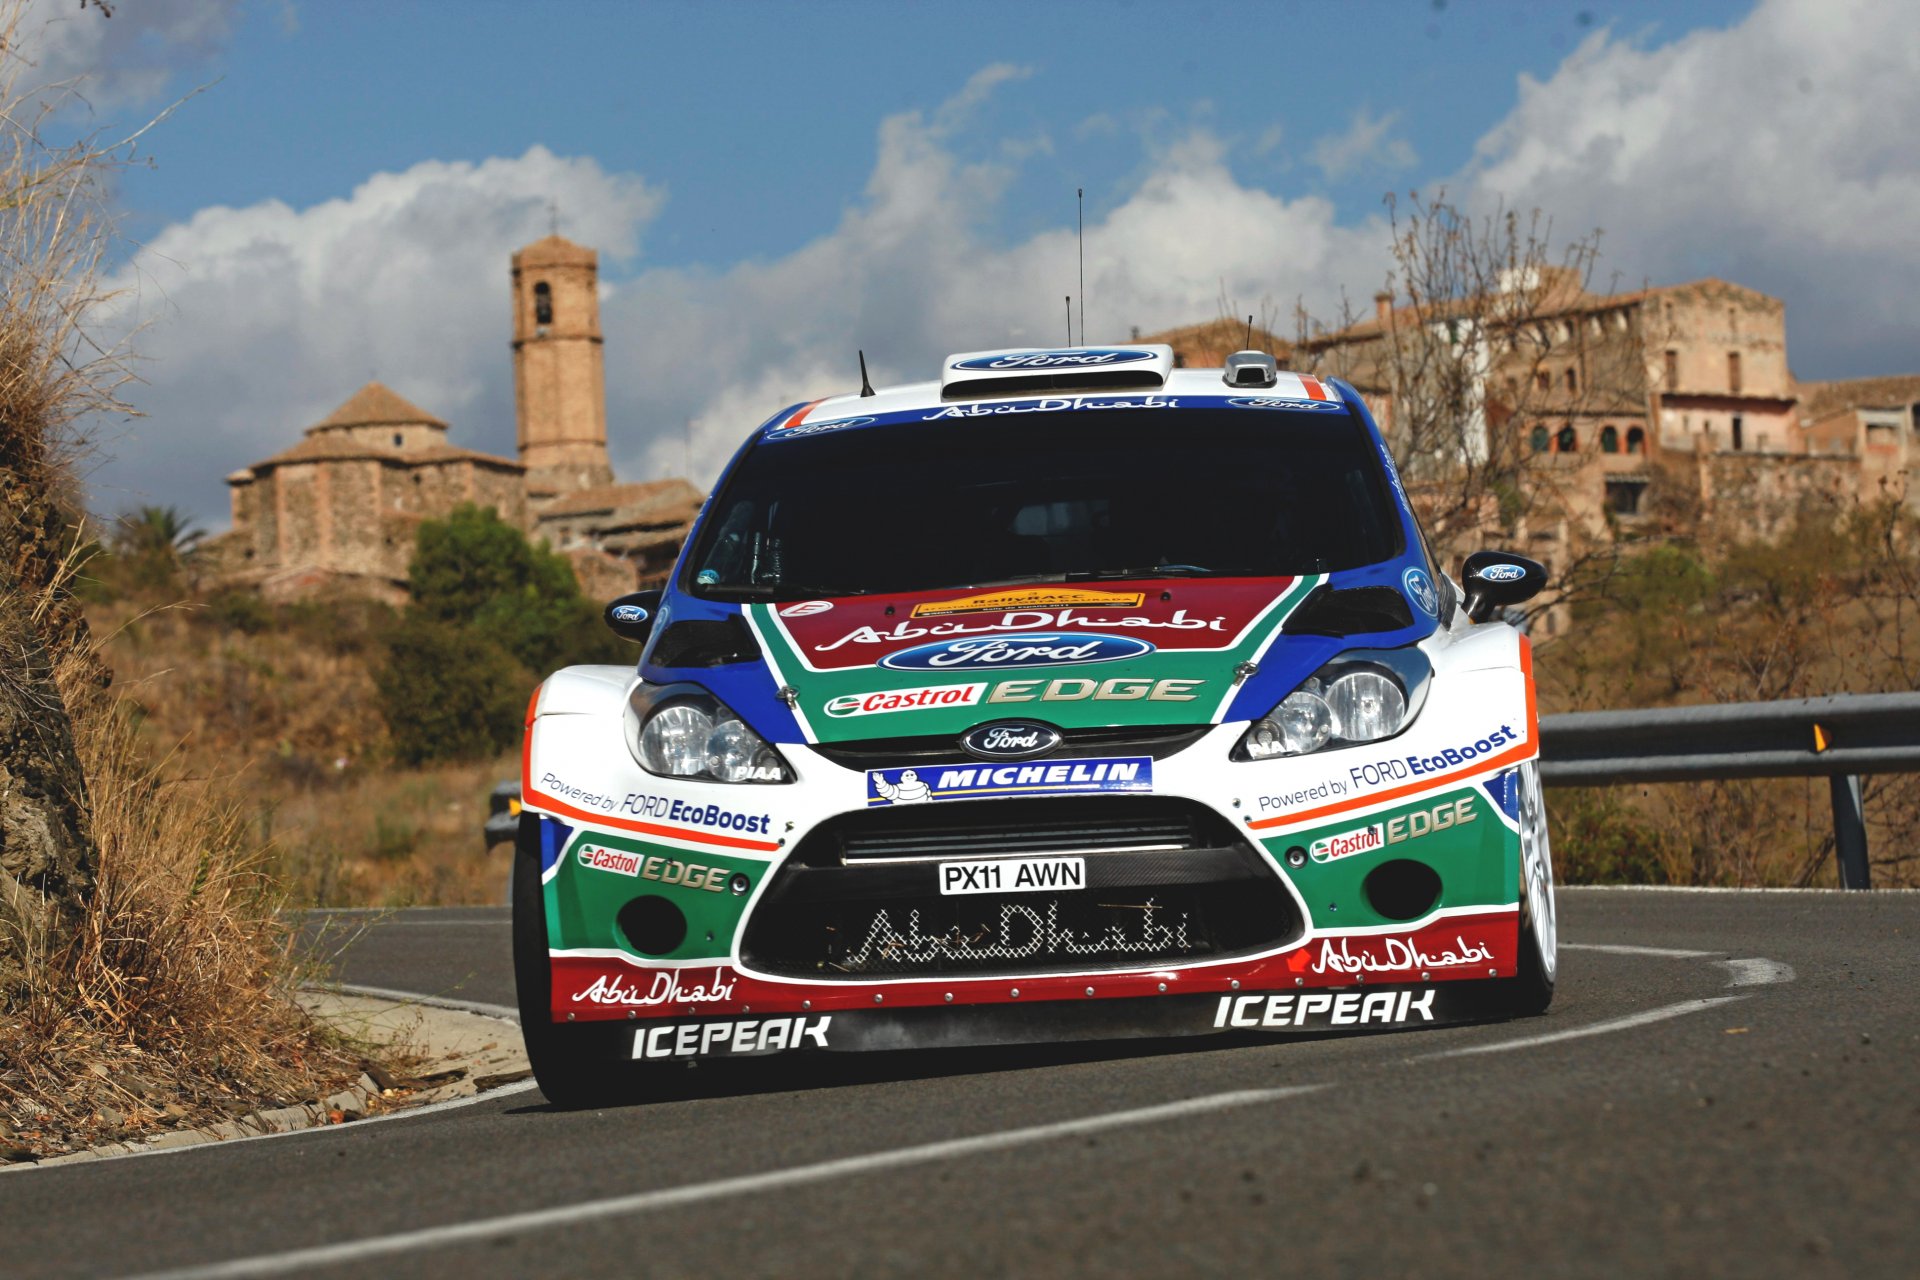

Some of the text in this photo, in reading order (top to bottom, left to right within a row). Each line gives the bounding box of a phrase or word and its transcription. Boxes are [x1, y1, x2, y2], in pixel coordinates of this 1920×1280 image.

[989, 349, 1116, 368] Ford
[1248, 398, 1320, 410] Ford
[1490, 565, 1519, 579] Ford
[616, 606, 640, 621] Ford
[928, 636, 1104, 666] Ford
[862, 678, 1207, 711] Castrol EDGE
[983, 727, 1038, 749] Ford
[733, 766, 782, 780] PIAA
[937, 763, 1140, 789] MICHELIN
[1258, 723, 1518, 812] Powered by FORD EcoBoost
[540, 772, 772, 835] Powered by FORD EcoBoost
[1330, 795, 1478, 858] Castrol EDGE
[592, 848, 731, 893] Castrol EDGE
[944, 861, 1081, 890] PX11 AWN
[1213, 989, 1437, 1029] ICEPEAK
[631, 1015, 833, 1060] ICEPEAK
